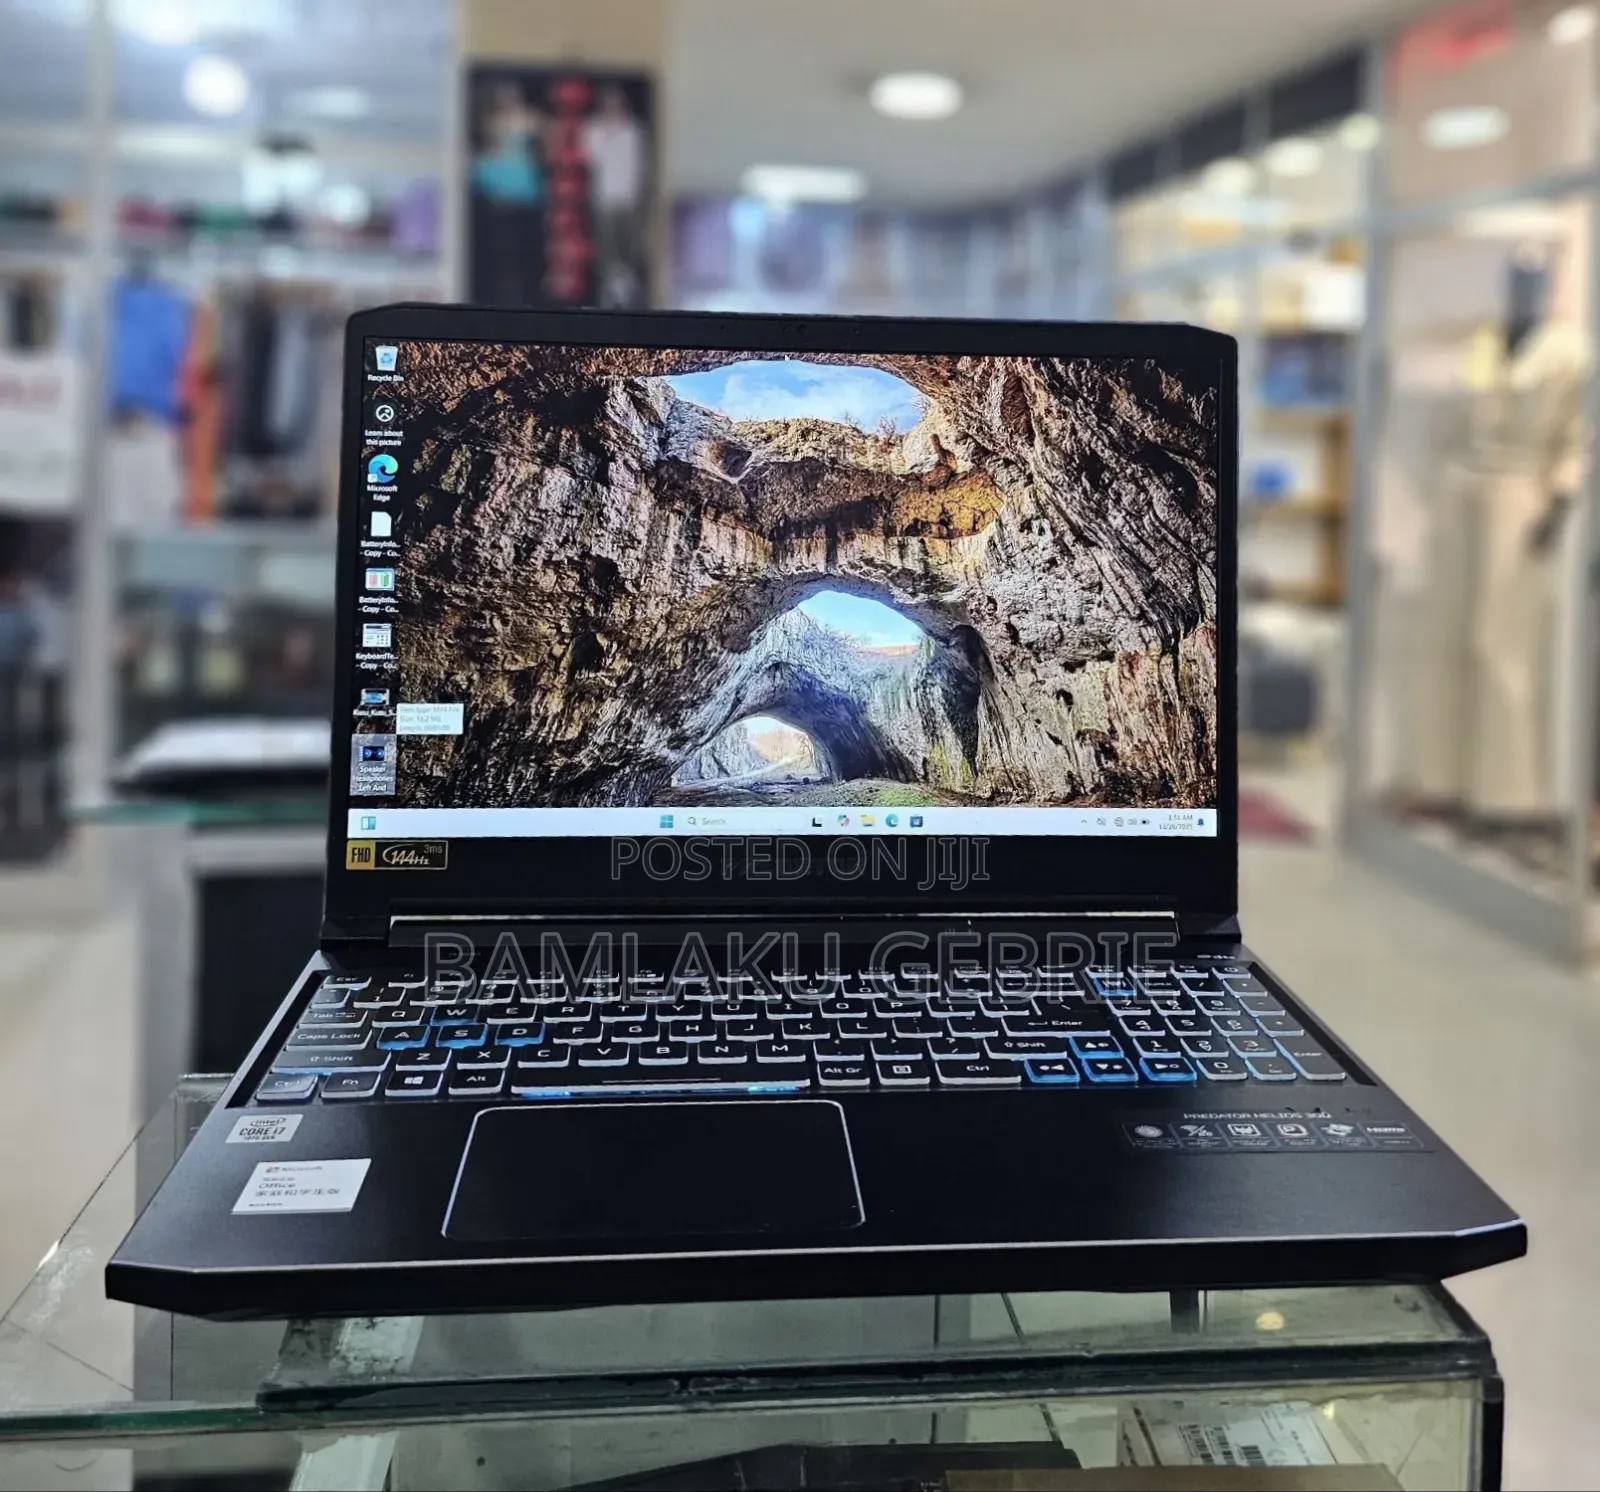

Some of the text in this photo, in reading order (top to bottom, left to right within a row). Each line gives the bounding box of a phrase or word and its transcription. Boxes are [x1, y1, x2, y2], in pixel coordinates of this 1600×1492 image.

[368, 374, 392, 382] Recycle
[373, 494, 391, 502] Edge
[360, 662, 378, 670] Copy
[701, 817, 726, 826] Search
[424, 844, 443, 854] 3ms
[351, 847, 371, 863] FHD
[672, 1004, 685, 1012] Y
[454, 1029, 469, 1037] S
[572, 1026, 585, 1034] F
[394, 1031, 409, 1039] A
[537, 1050, 551, 1058] C
[597, 1047, 612, 1055] V
[656, 1046, 670, 1054] B
[477, 1051, 491, 1059] X
[239, 1127, 271, 1136] CORE
